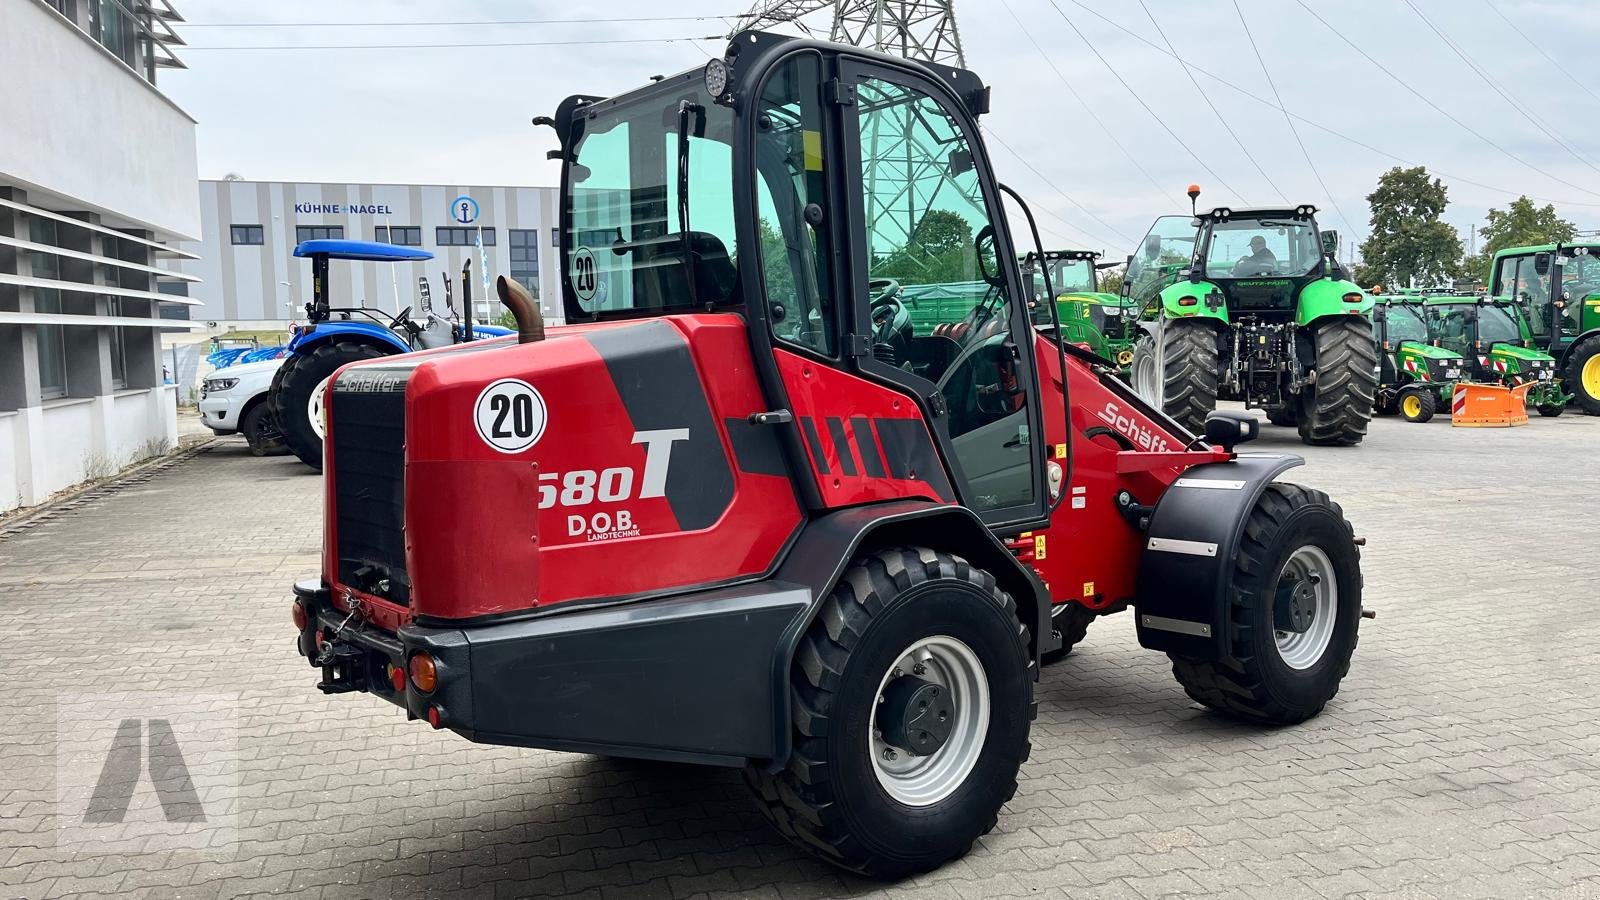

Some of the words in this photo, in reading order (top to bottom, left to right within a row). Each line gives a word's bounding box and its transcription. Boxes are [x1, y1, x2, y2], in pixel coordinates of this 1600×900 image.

[576, 256, 595, 291] 20
[490, 393, 534, 438] 20
[1097, 402, 1172, 452] Schäff
[567, 510, 638, 537] D.O.B.
[587, 529, 641, 542] LANDTECHNIK
